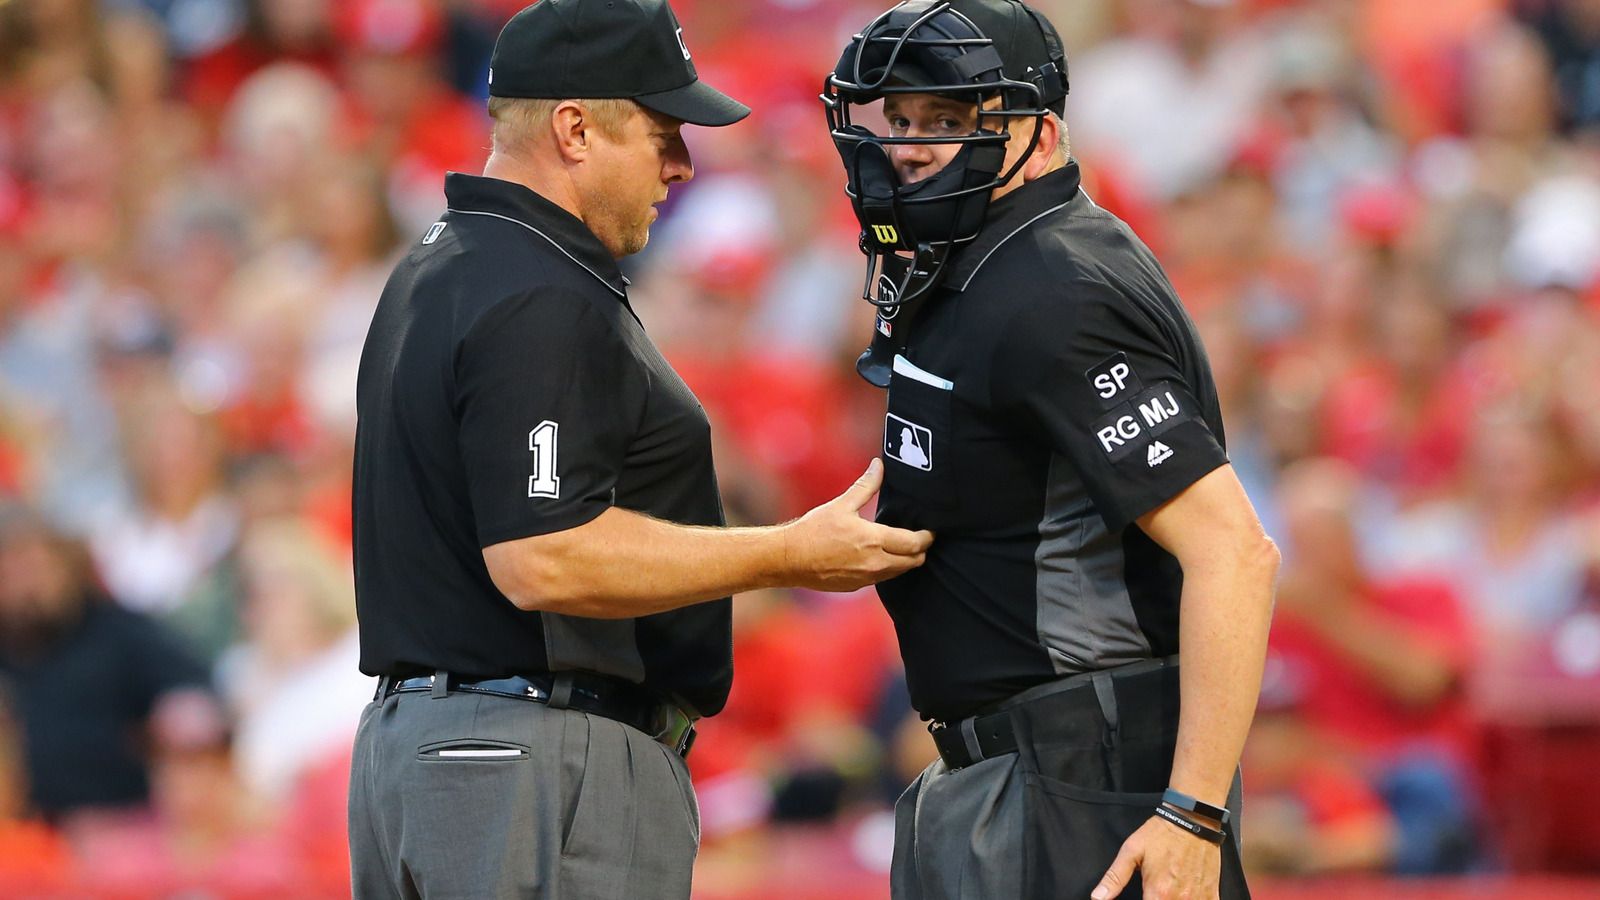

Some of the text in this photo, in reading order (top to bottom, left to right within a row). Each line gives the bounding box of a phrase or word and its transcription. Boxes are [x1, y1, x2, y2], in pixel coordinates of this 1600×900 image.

[1094, 363, 1129, 399] SP
[1096, 391, 1180, 453] RG MJ
[528, 419, 560, 499] 1
